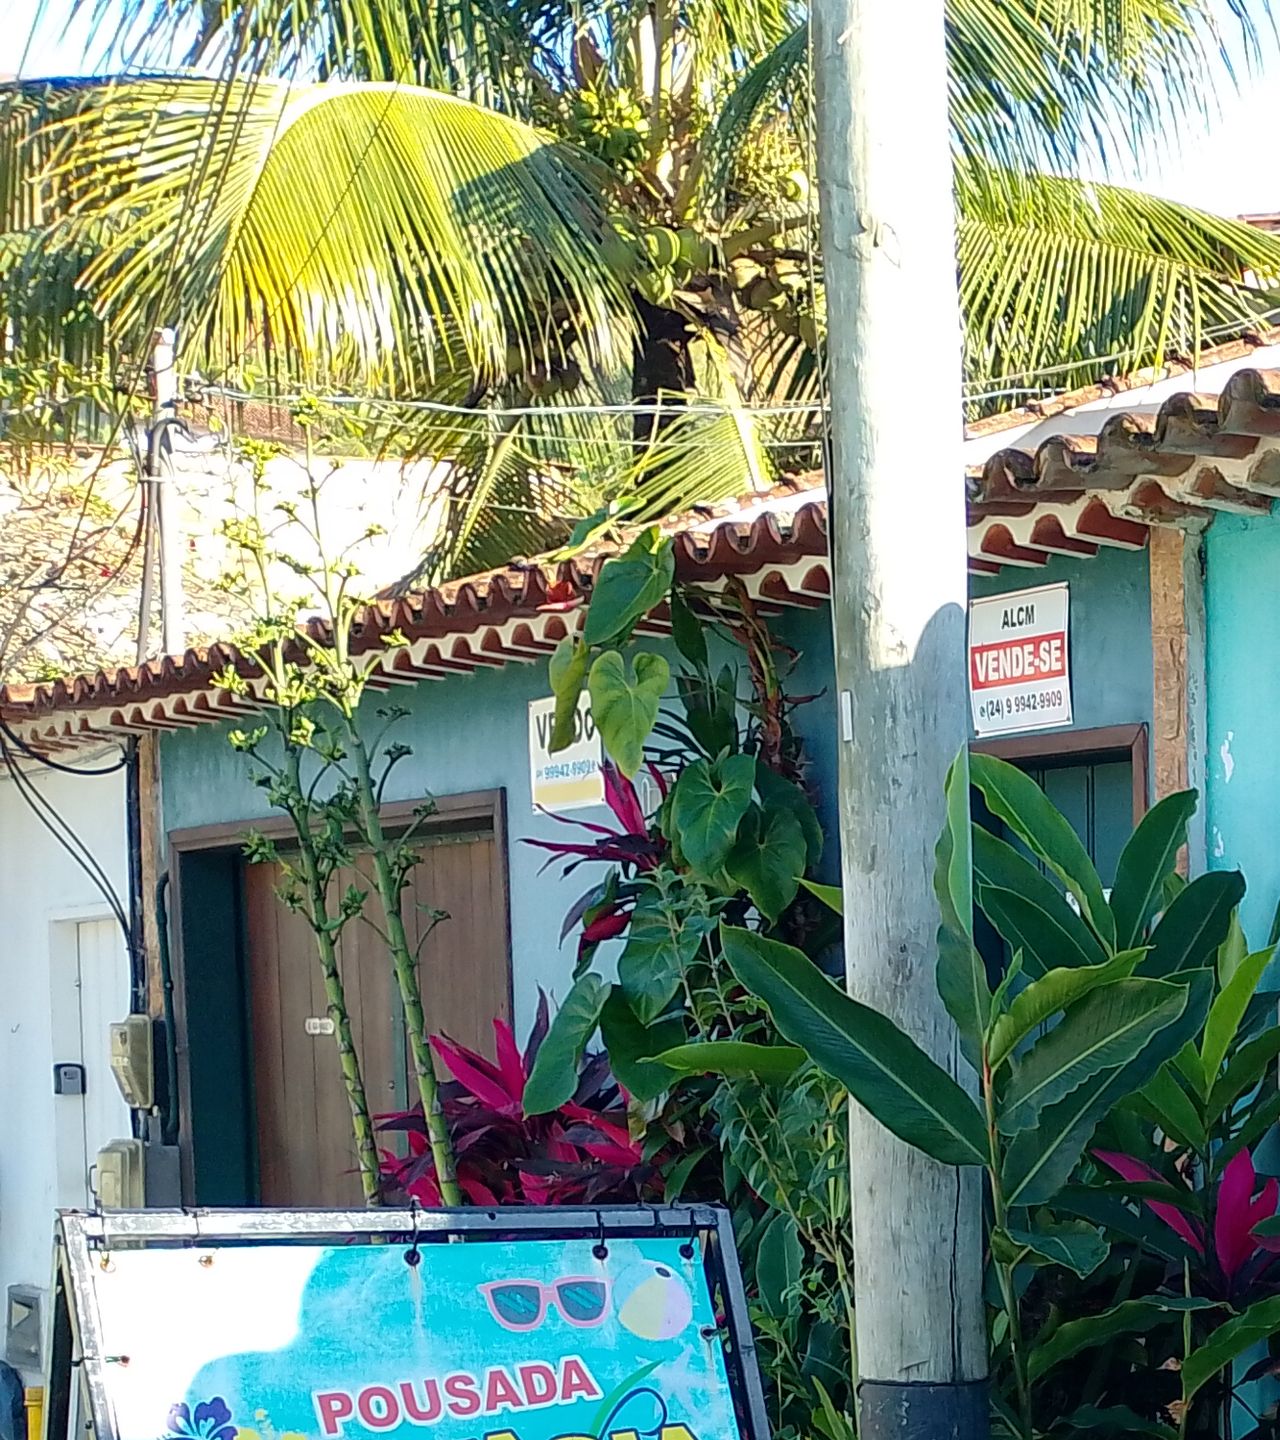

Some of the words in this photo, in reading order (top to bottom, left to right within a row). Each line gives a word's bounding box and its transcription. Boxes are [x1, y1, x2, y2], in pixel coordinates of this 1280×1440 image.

[1001, 604, 1035, 629] ALCM
[975, 639, 1063, 683] VENDE-SE
[986, 698, 1004, 721] (24)
[1005, 696, 1012, 714] 9
[1014, 690, 1063, 714] 9942-9909
[316, 1359, 599, 1434] POUSADA
